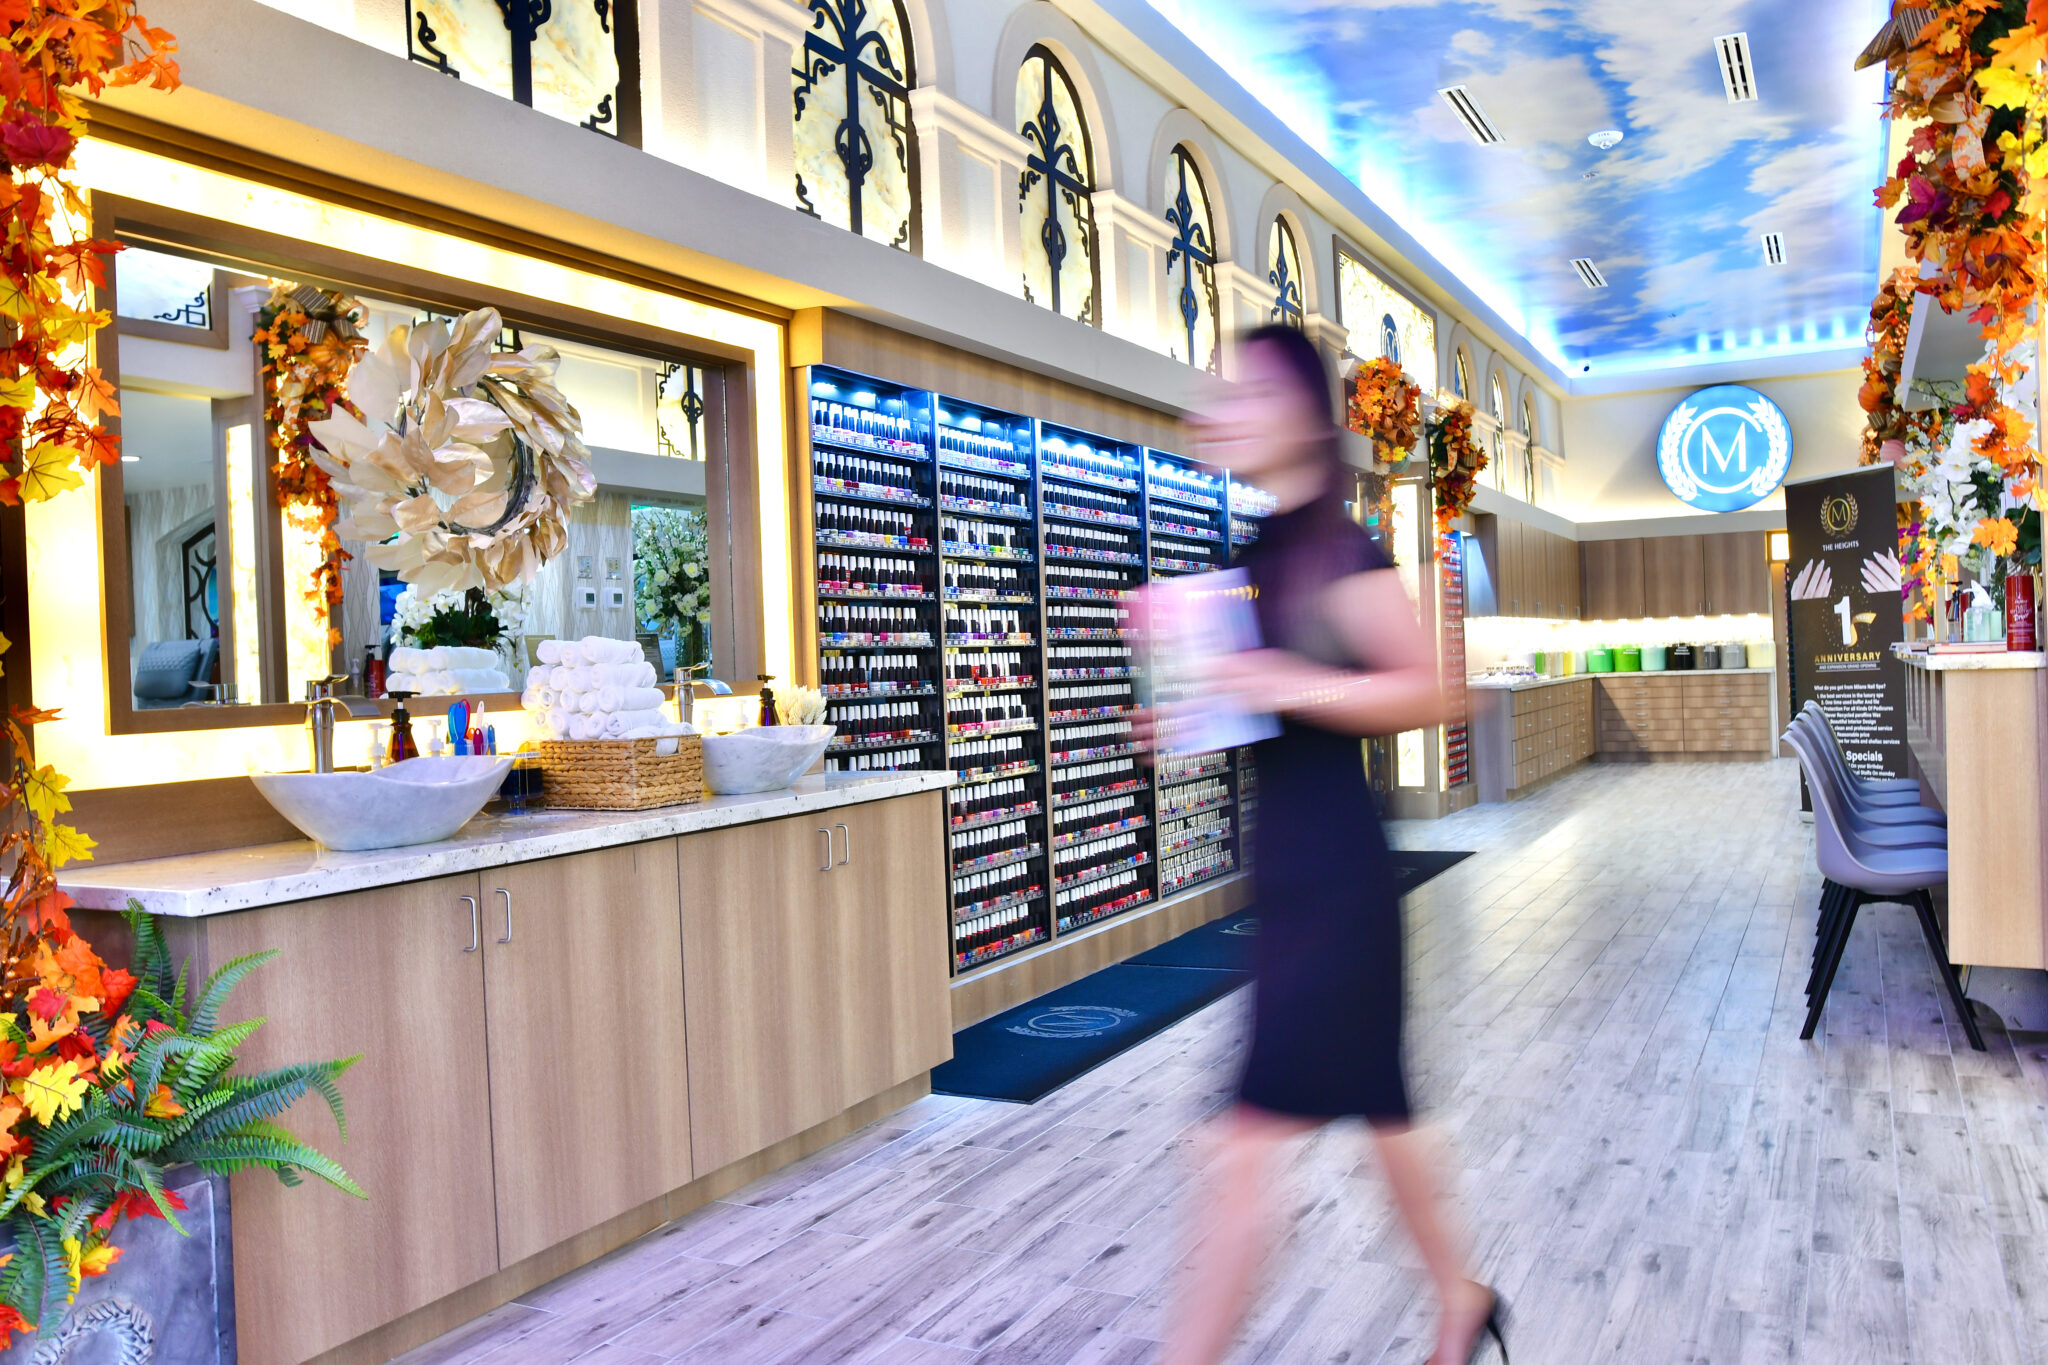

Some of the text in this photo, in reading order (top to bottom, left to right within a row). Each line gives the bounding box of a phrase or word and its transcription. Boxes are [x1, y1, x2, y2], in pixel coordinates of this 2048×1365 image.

[1822, 540, 1860, 552] THE HEIGHTS
[1834, 595, 1852, 646] 1
[1814, 651, 1881, 663] ANNIVERSARY
[1846, 750, 1883, 763] Specials
